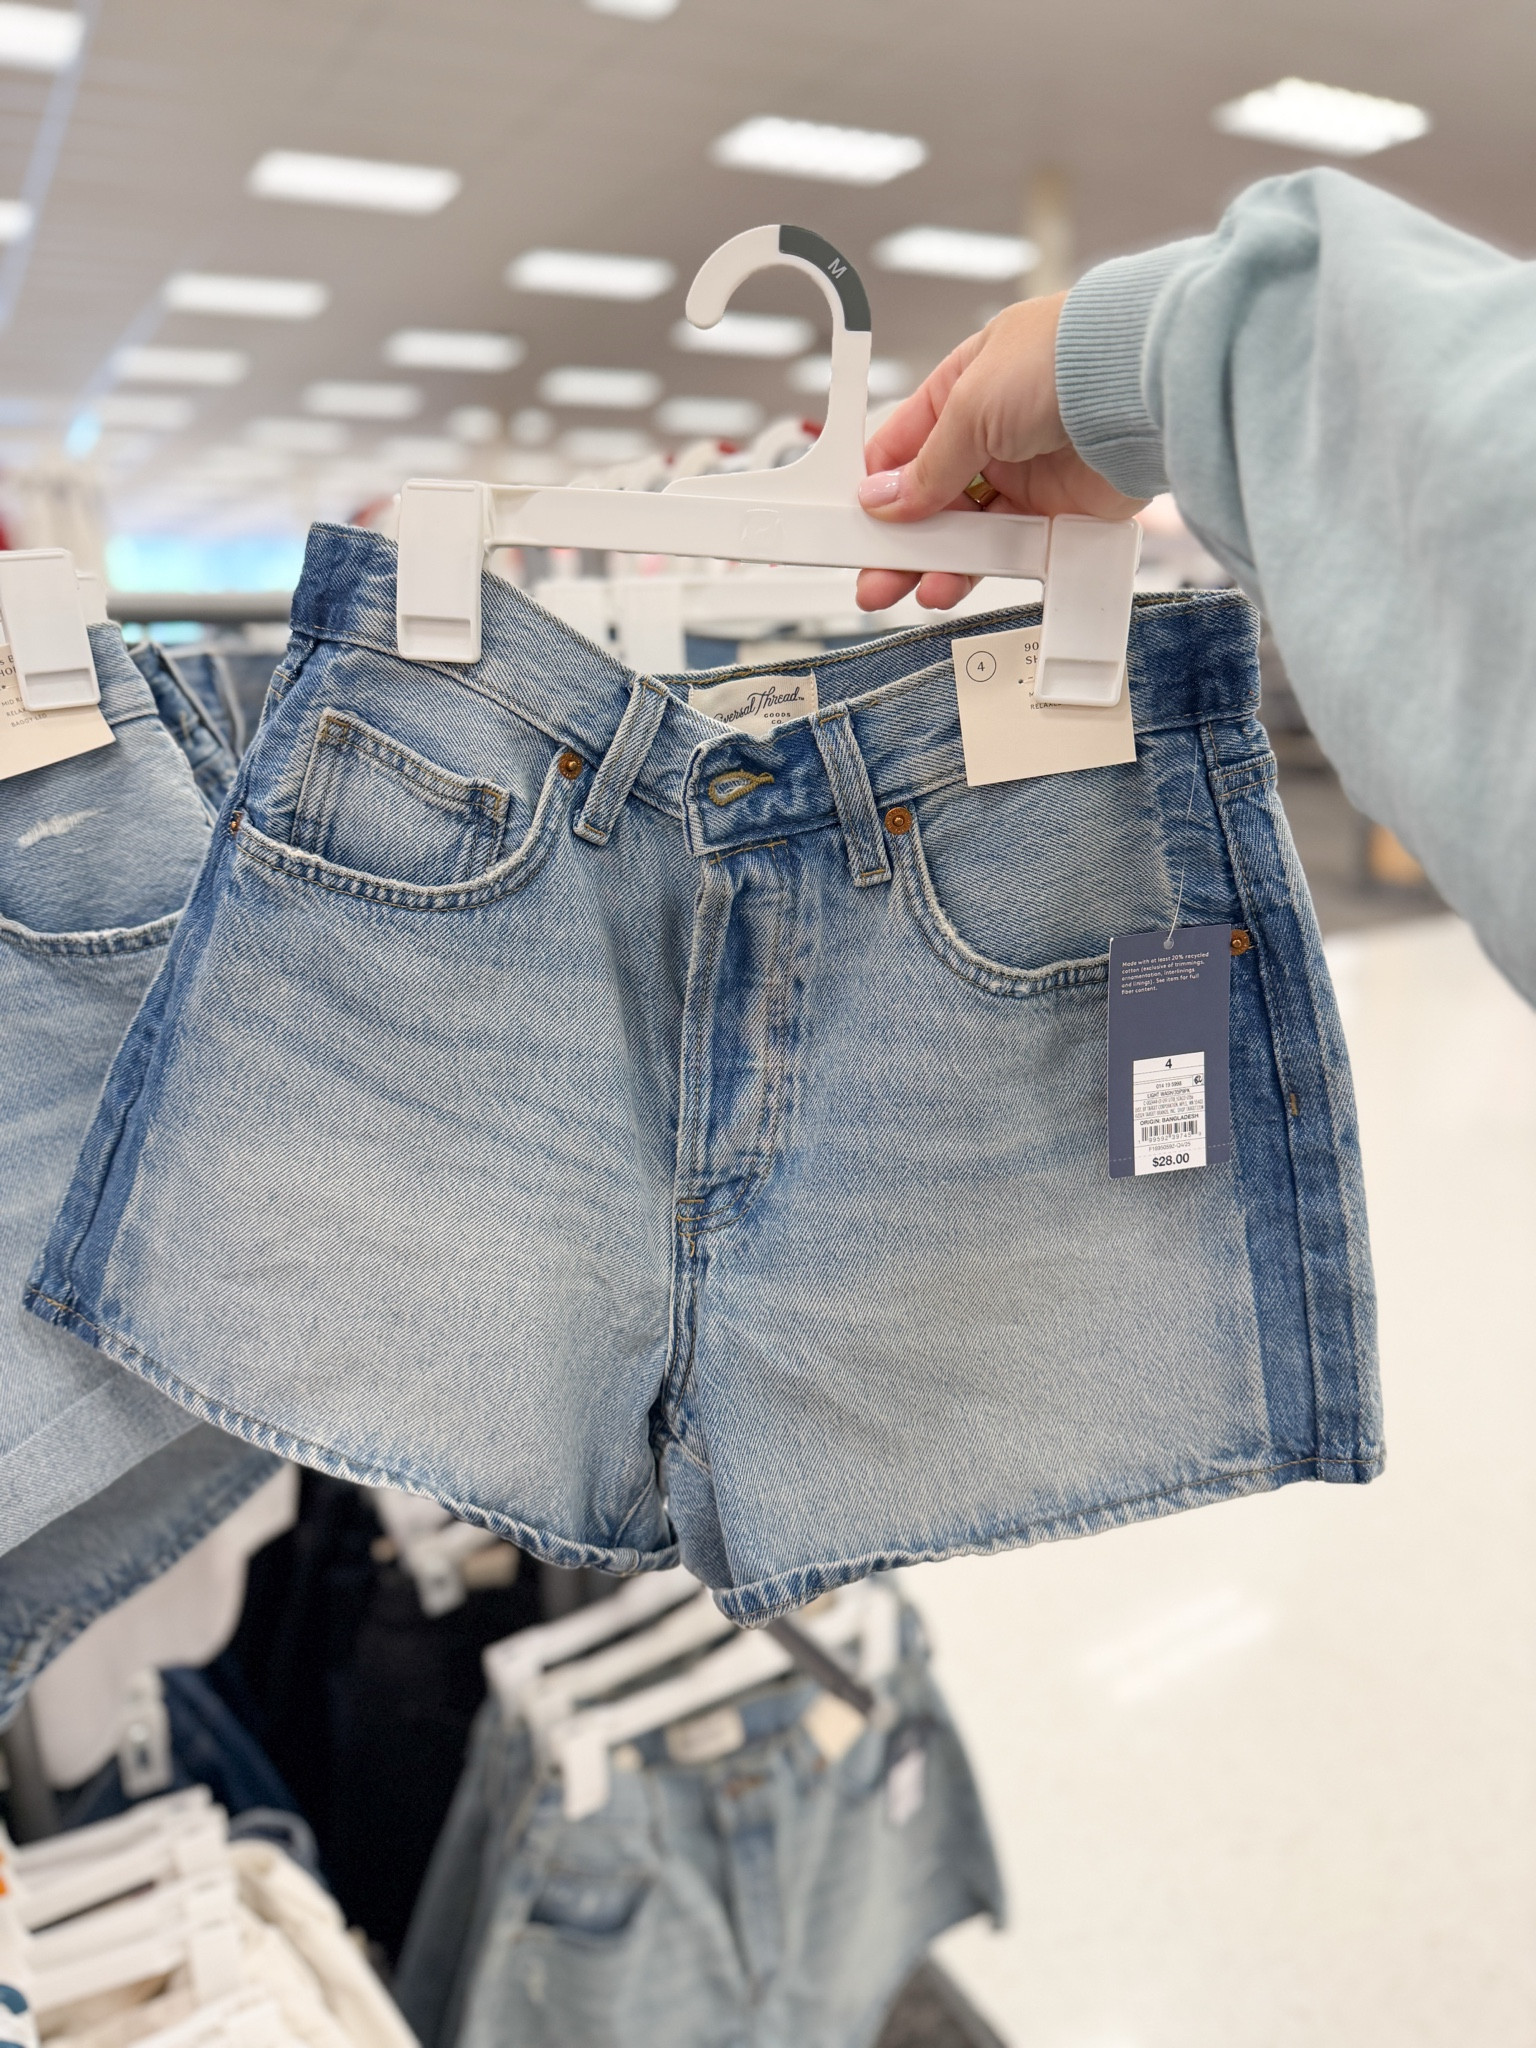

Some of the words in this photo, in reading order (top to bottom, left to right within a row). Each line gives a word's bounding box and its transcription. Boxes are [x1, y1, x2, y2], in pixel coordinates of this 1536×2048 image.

[828, 257, 847, 279] M
[977, 661, 985, 672] 4
[714, 697, 756, 723] versal
[11, 717, 33, 728] BAGGY
[1185, 952, 1210, 960] recycled
[1140, 964, 1167, 972] (exclusive
[1163, 967, 1195, 976] interlinings
[1165, 1058, 1172, 1069] 4
[1140, 1118, 1161, 1126] ORIGIN:
[1161, 1113, 1199, 1123] BANGLADESH
[1152, 1152, 1190, 1168] $28.00
